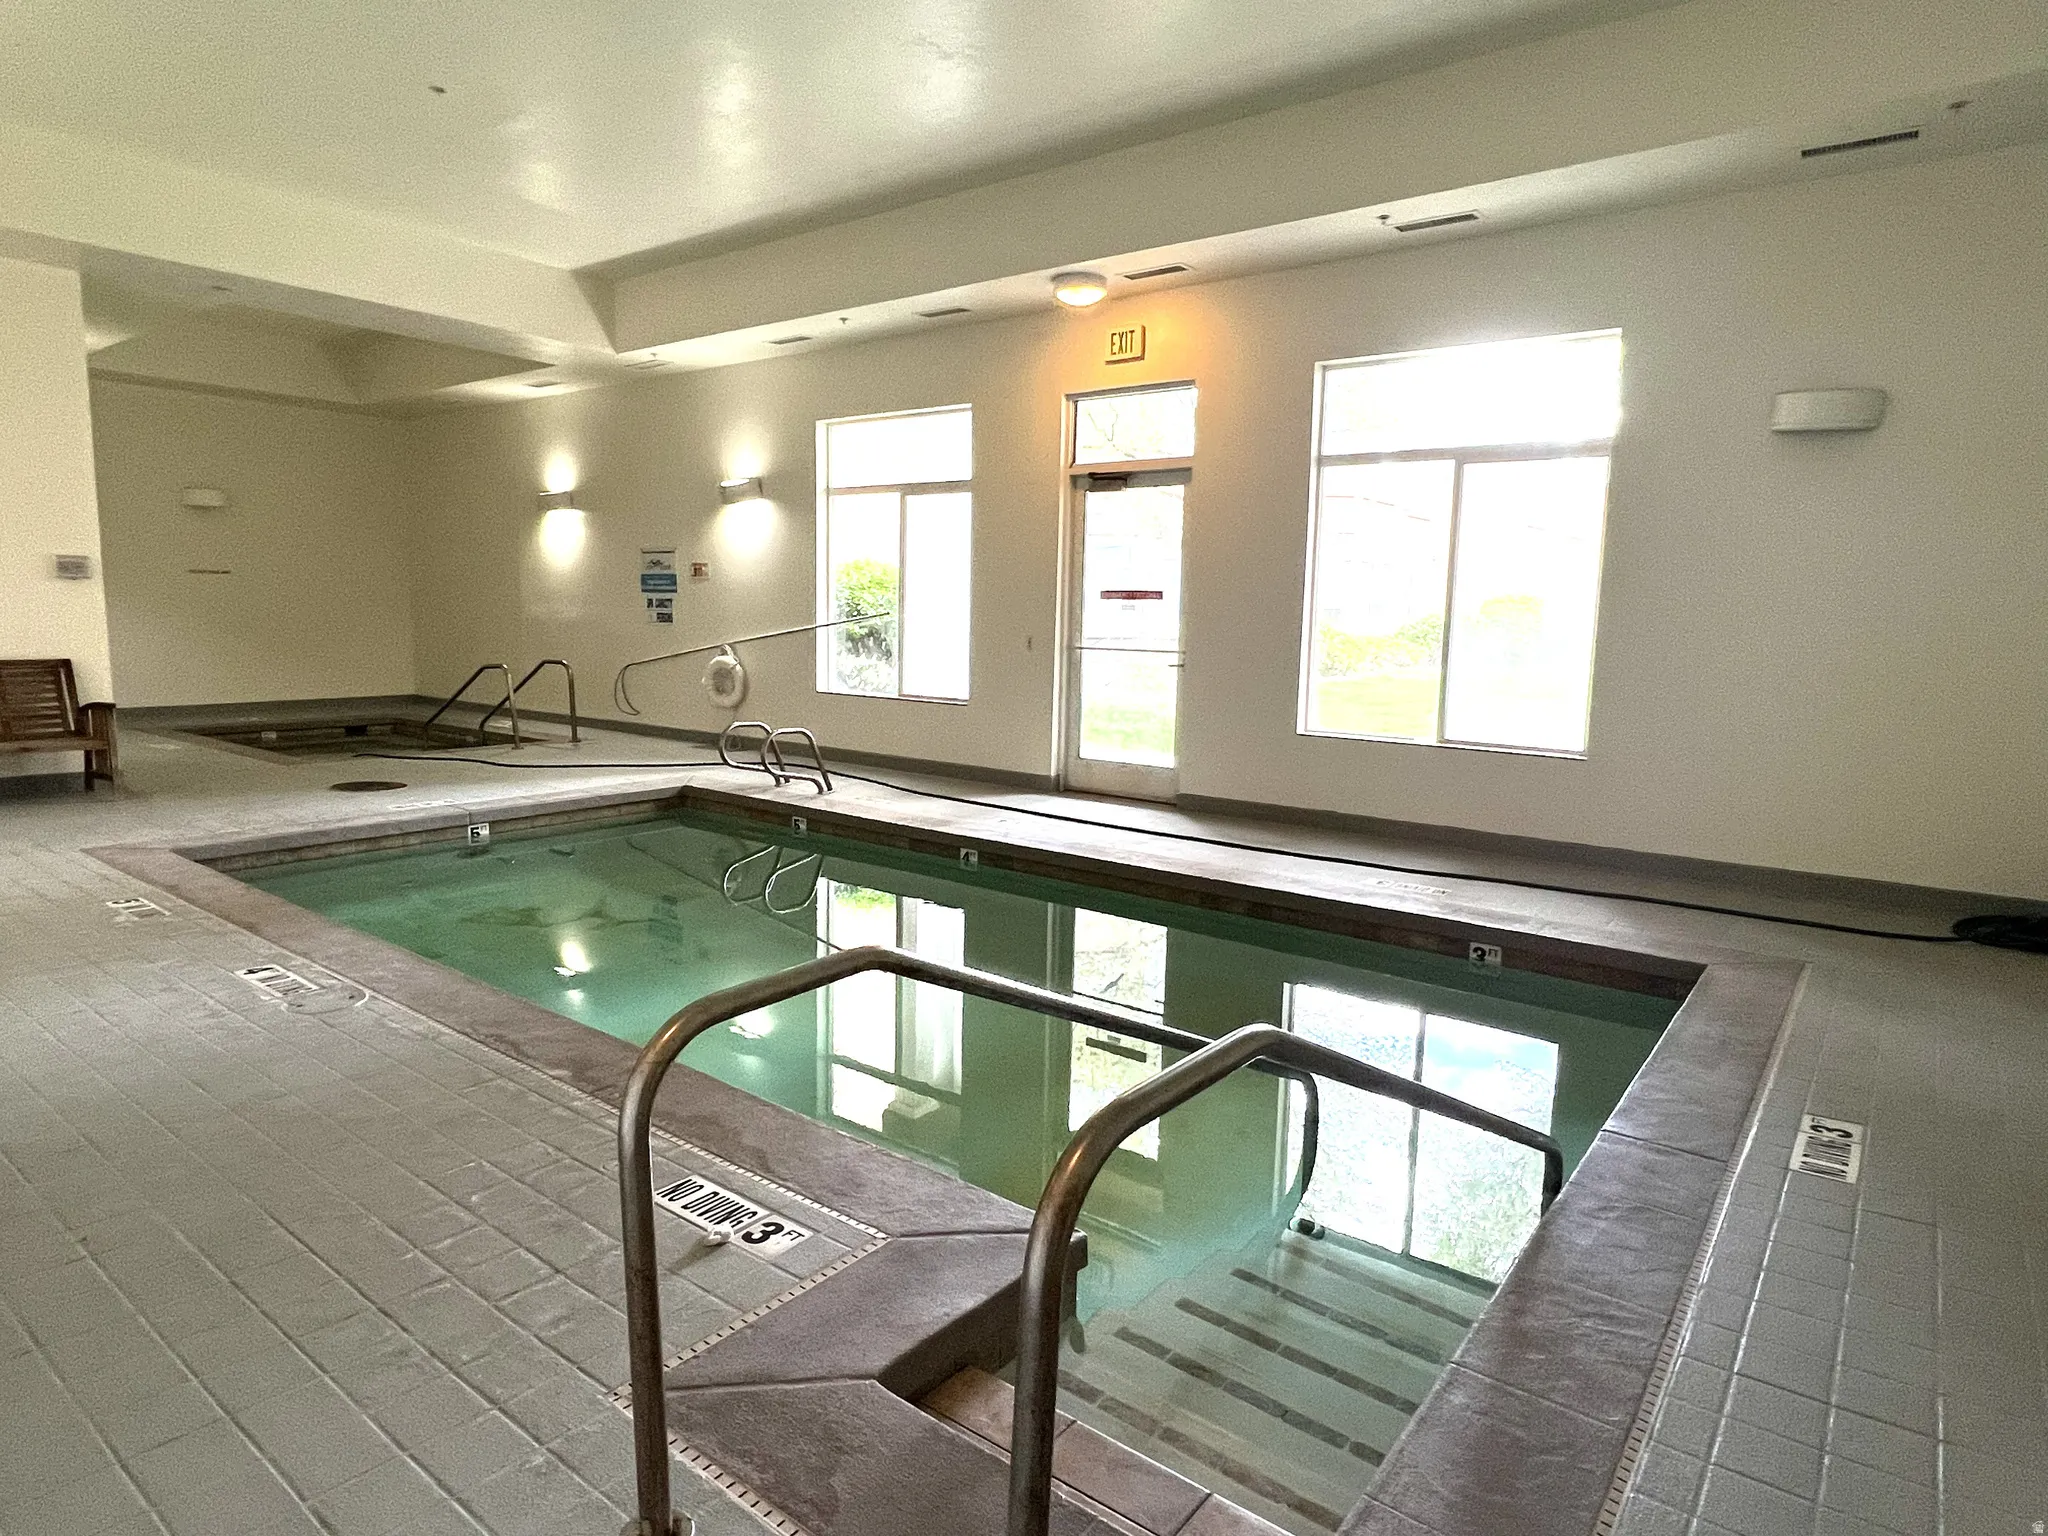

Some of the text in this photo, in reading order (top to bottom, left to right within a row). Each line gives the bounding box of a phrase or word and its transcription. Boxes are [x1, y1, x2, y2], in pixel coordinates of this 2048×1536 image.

[1110, 329, 1135, 355] EXIT
[470, 826, 481, 838] 5
[1472, 946, 1487, 962] 3
[1809, 1124, 1854, 1138] 3
[656, 1178, 806, 1245] NO DIVING 3 FT
